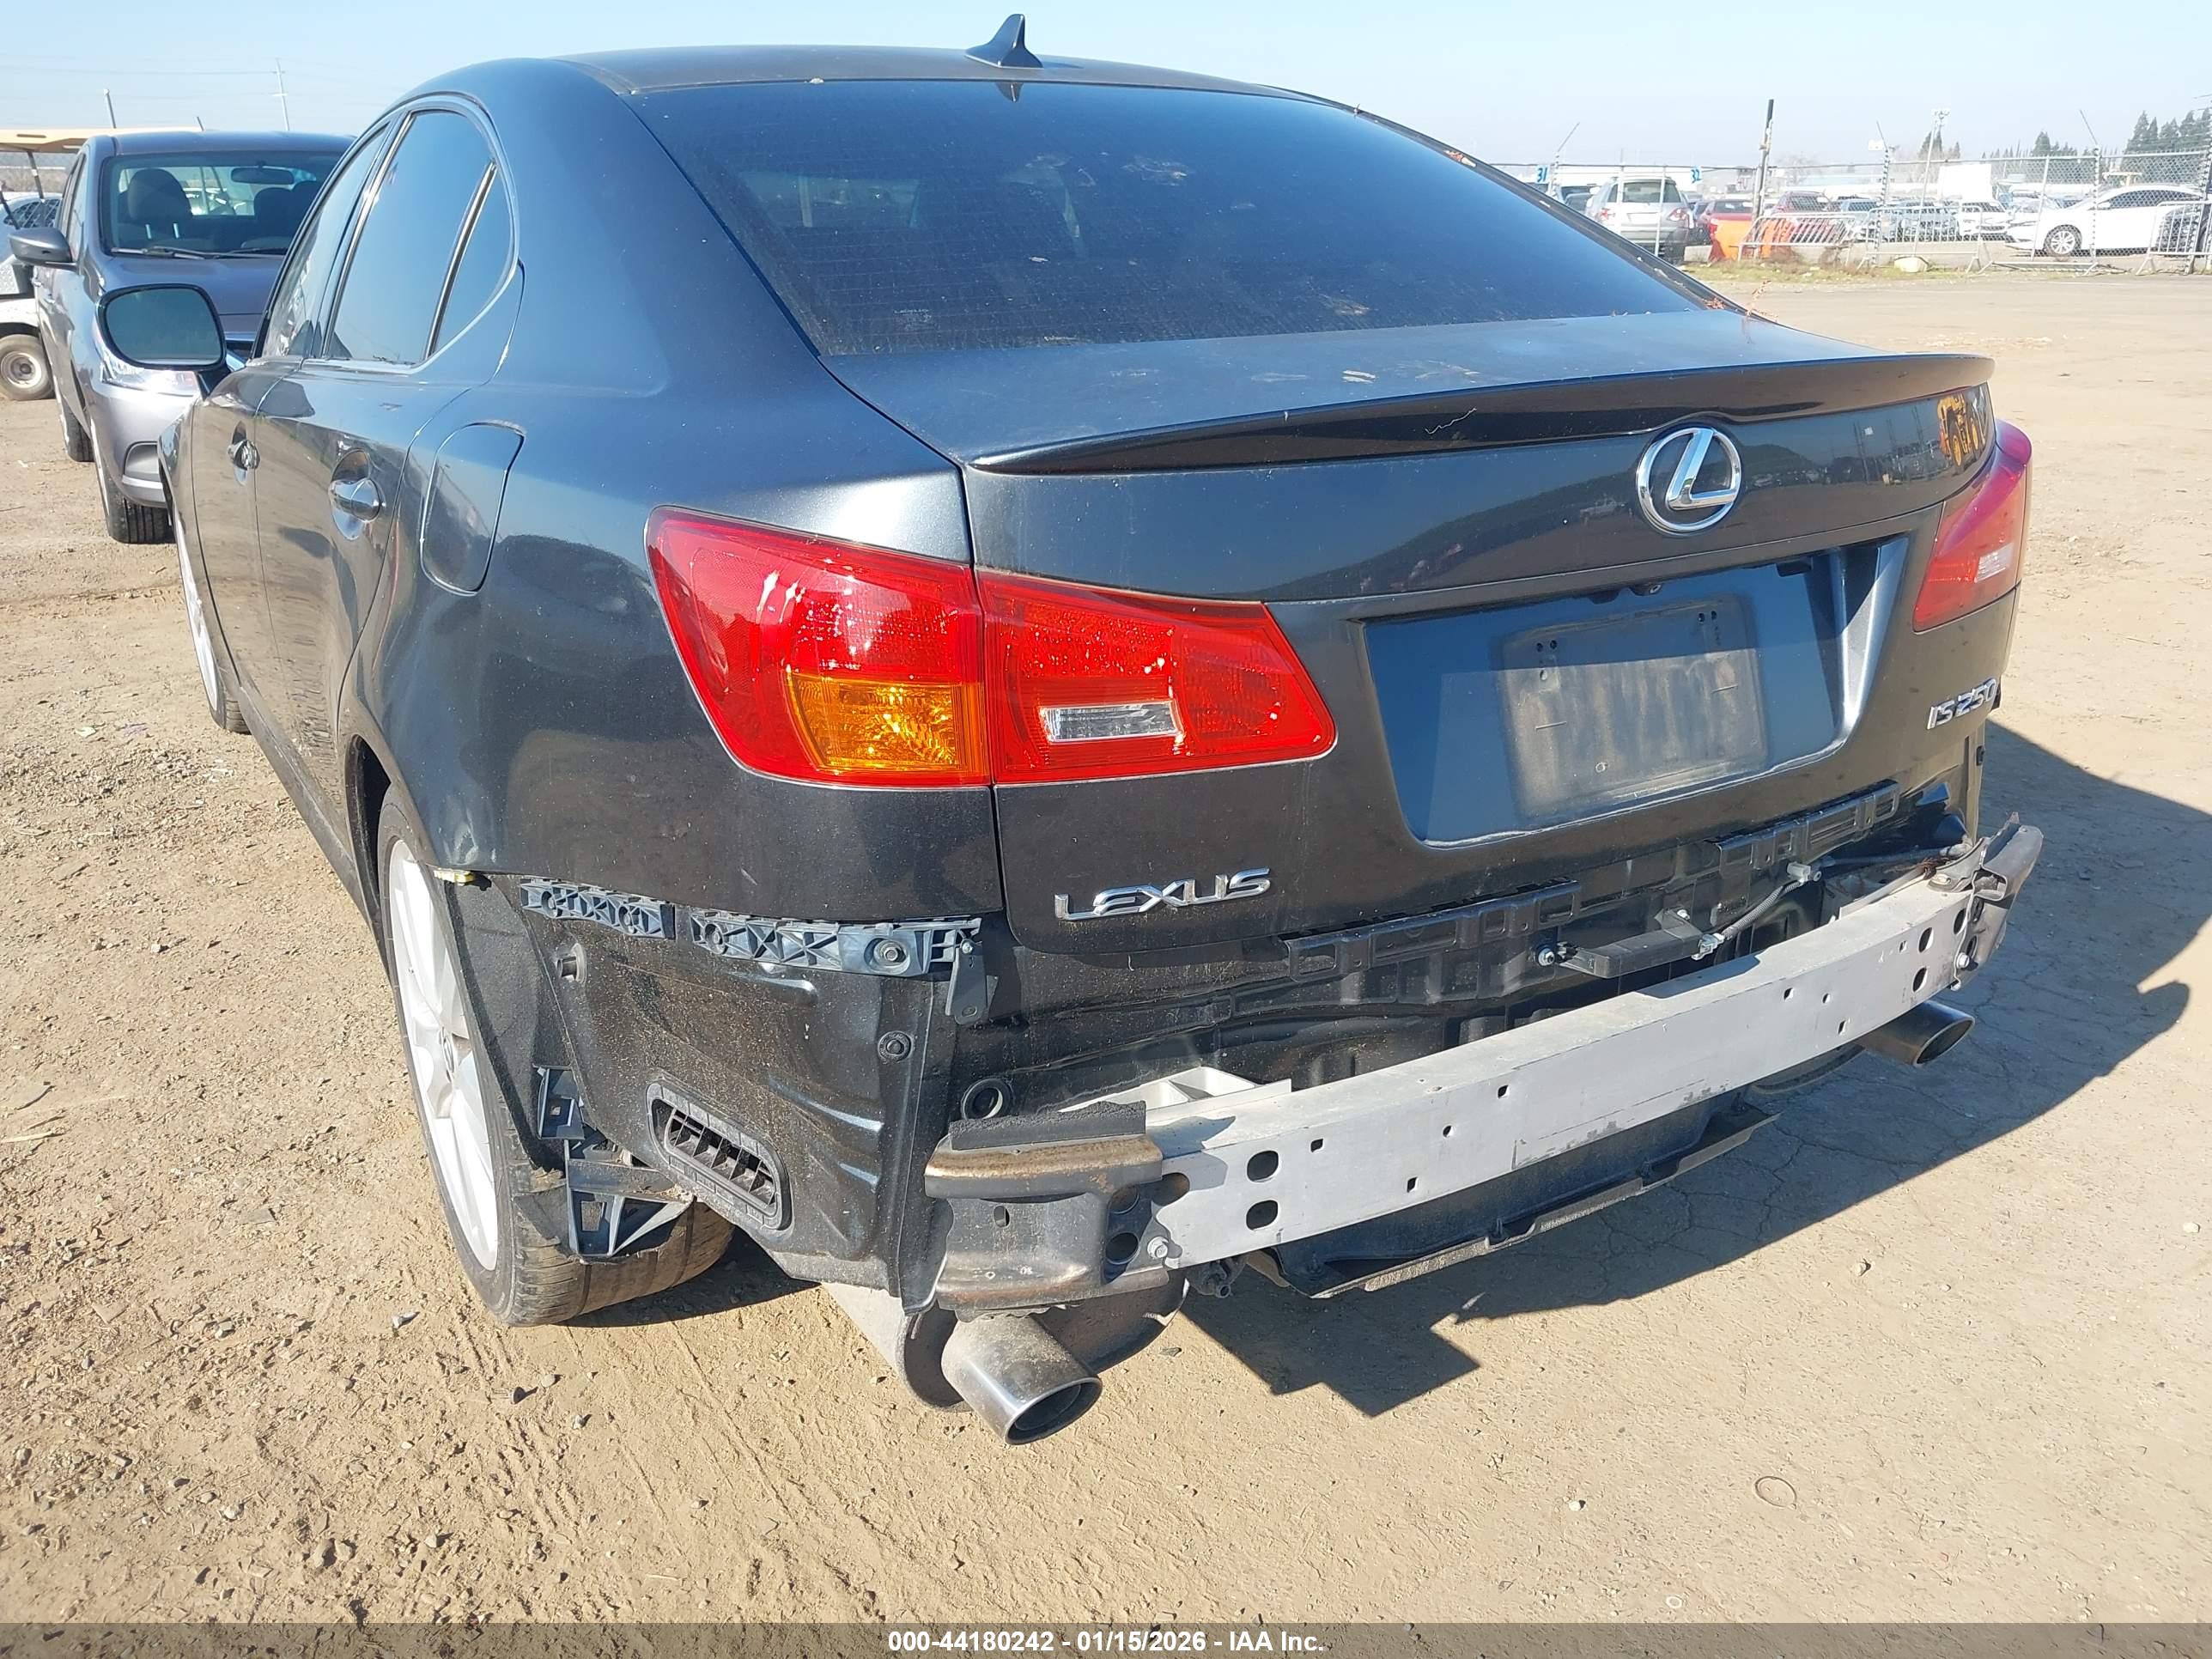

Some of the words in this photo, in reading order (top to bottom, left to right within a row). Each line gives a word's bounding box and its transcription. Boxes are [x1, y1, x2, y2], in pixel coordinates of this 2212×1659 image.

[1537, 167, 1548, 183] 31
[1927, 700, 1955, 730] IS
[1954, 678, 1996, 718] 250
[1054, 866, 1272, 921] LEXUS
